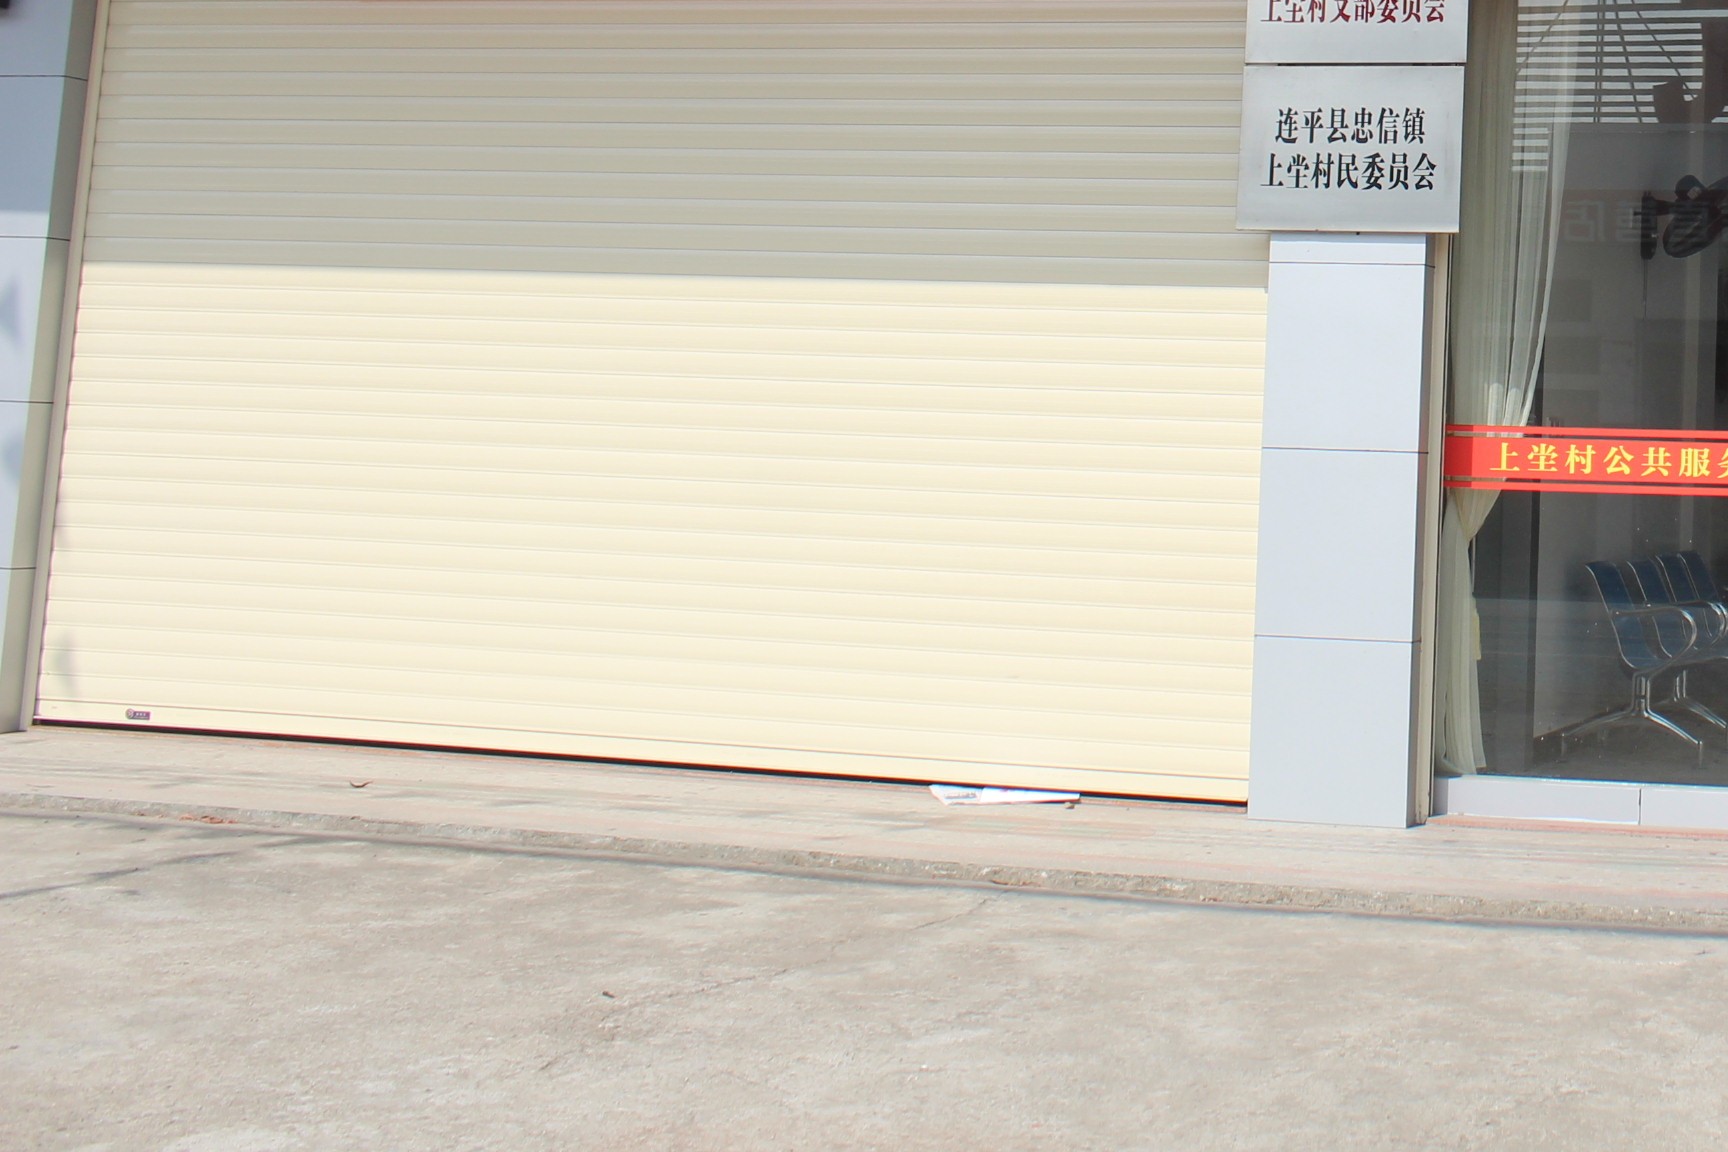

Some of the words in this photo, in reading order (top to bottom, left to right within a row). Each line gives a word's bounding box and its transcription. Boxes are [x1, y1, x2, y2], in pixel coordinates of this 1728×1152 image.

[1275, 107, 1426, 145] 连平县忠信镇
